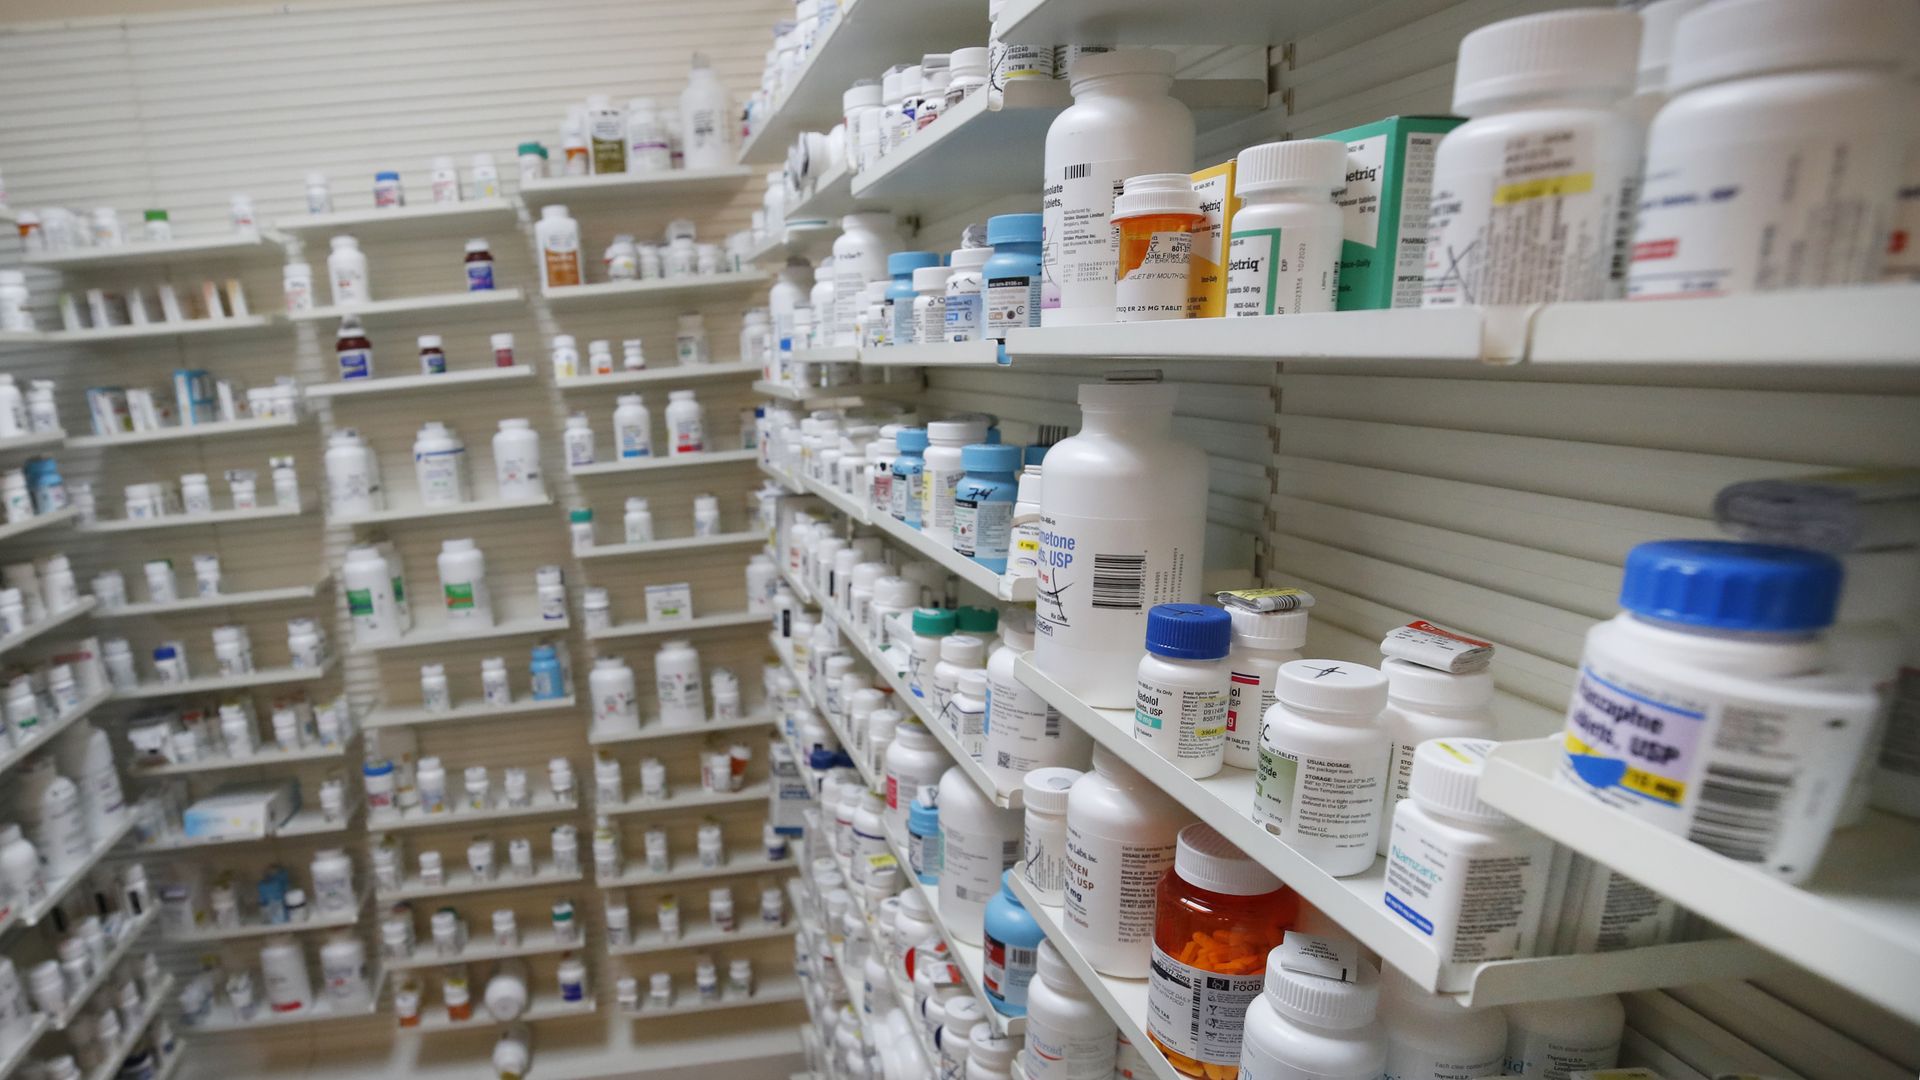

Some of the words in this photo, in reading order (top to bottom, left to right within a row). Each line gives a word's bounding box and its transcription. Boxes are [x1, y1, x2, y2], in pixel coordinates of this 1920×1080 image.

[1049, 550, 1073, 568] USP
[1276, 750, 1298, 761] TABLETS
[1307, 759, 1325, 767] USUAL
[1305, 774, 1333, 782] STORAGE:
[1077, 877, 1094, 890] USP
